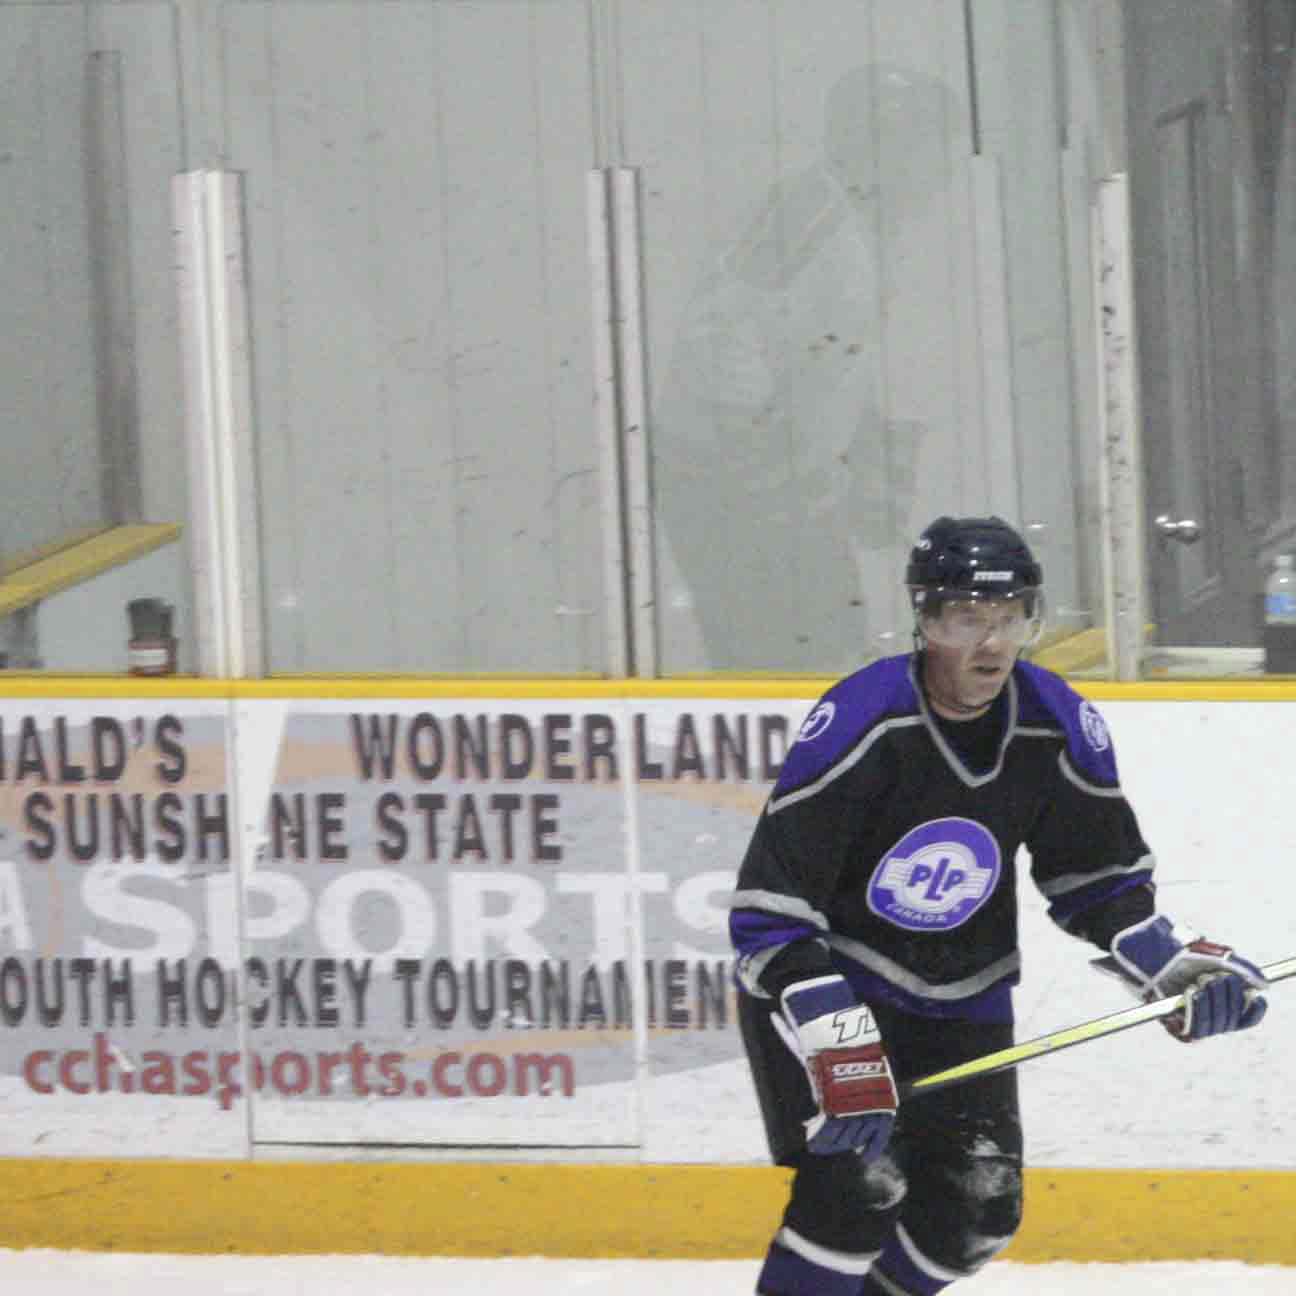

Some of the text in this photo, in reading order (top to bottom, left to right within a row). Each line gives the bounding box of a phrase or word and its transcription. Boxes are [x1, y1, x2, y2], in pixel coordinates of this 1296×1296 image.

[0, 713, 188, 784] ALD'S
[349, 711, 790, 783] WONDERLAND
[24, 790, 565, 864] SUNSHNE STATE
[157, 956, 373, 1030] HOCKEY
[395, 956, 728, 1032] TOURNAMEN
[23, 1031, 576, 1112] cchasports.com
